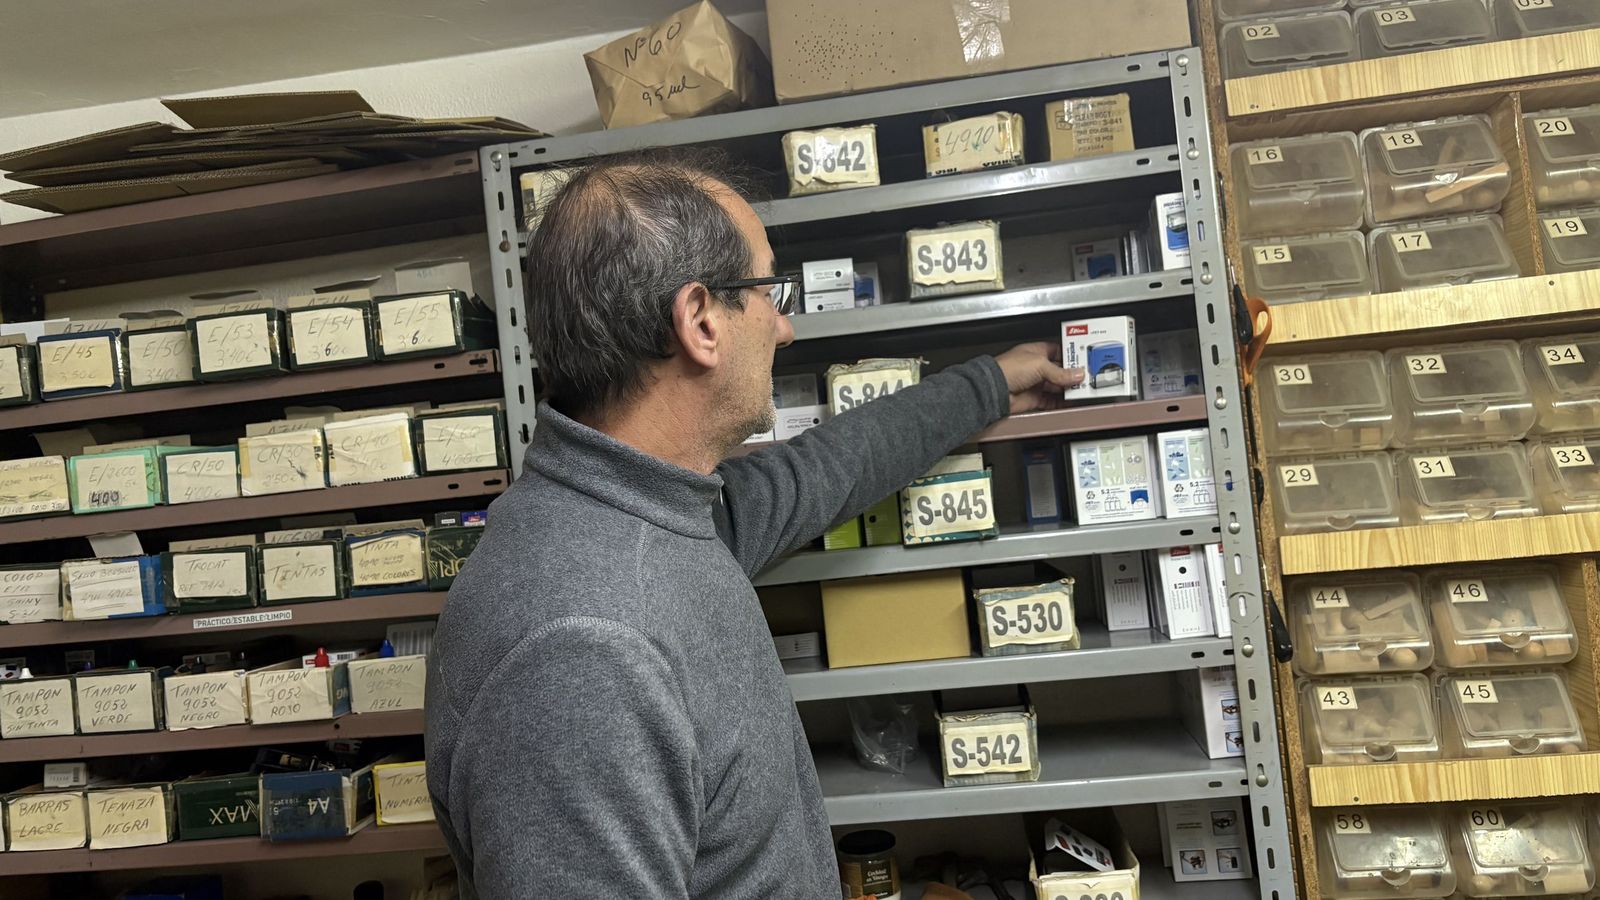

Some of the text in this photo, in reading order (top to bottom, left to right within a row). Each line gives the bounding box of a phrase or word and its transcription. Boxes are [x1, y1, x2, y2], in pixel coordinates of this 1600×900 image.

[1380, 10, 1410, 23] 03
[1245, 25, 1274, 38] 02
[1539, 120, 1568, 133] 20
[945, 125, 995, 155] 4910
[1387, 133, 1416, 146] 18
[798, 140, 866, 174] S-842
[1252, 148, 1278, 161] 16
[1551, 220, 1579, 234] 19
[1398, 234, 1424, 248] 17
[917, 239, 988, 276] S-843
[1258, 247, 1286, 261] 15
[393, 301, 441, 327] E/55
[207, 321, 254, 344] E/53
[307, 315, 353, 337] E/54
[51, 342, 95, 364] E/45
[142, 338, 185, 359] E/50
[1547, 348, 1576, 363] 34
[1410, 358, 1440, 372] 32
[1279, 368, 1306, 382] 30
[1555, 449, 1586, 463] 33
[176, 459, 225, 475] CR/50
[1418, 460, 1447, 475] 31
[1284, 468, 1312, 483] 29
[917, 489, 987, 526] S-845
[268, 562, 327, 584] TINTAS
[1315, 589, 1342, 604] 44
[1453, 582, 1482, 598] 46
[991, 601, 1063, 637] S-530
[256, 670, 310, 688] TAMPON
[3, 688, 62, 705] TAMPON
[82, 684, 137, 699] TAMPON
[170, 682, 228, 699] TAMPON
[266, 687, 303, 704] 9052
[1322, 691, 1351, 706] 43
[1462, 684, 1491, 699] 45
[16, 703, 49, 719] 9052
[94, 698, 128, 713] 9052
[183, 697, 217, 712] 9052
[369, 698, 402, 710] AZUL
[92, 713, 132, 727] VERDE
[181, 711, 220, 723] NEGRO
[951, 734, 1022, 769] S-542
[19, 799, 71, 816] BARRAS
[97, 796, 155, 815] TENAZA
[307, 796, 330, 816] A4
[1336, 813, 1365, 829] 58
[1471, 810, 1500, 826] 60
[102, 818, 149, 836] NEGRA
